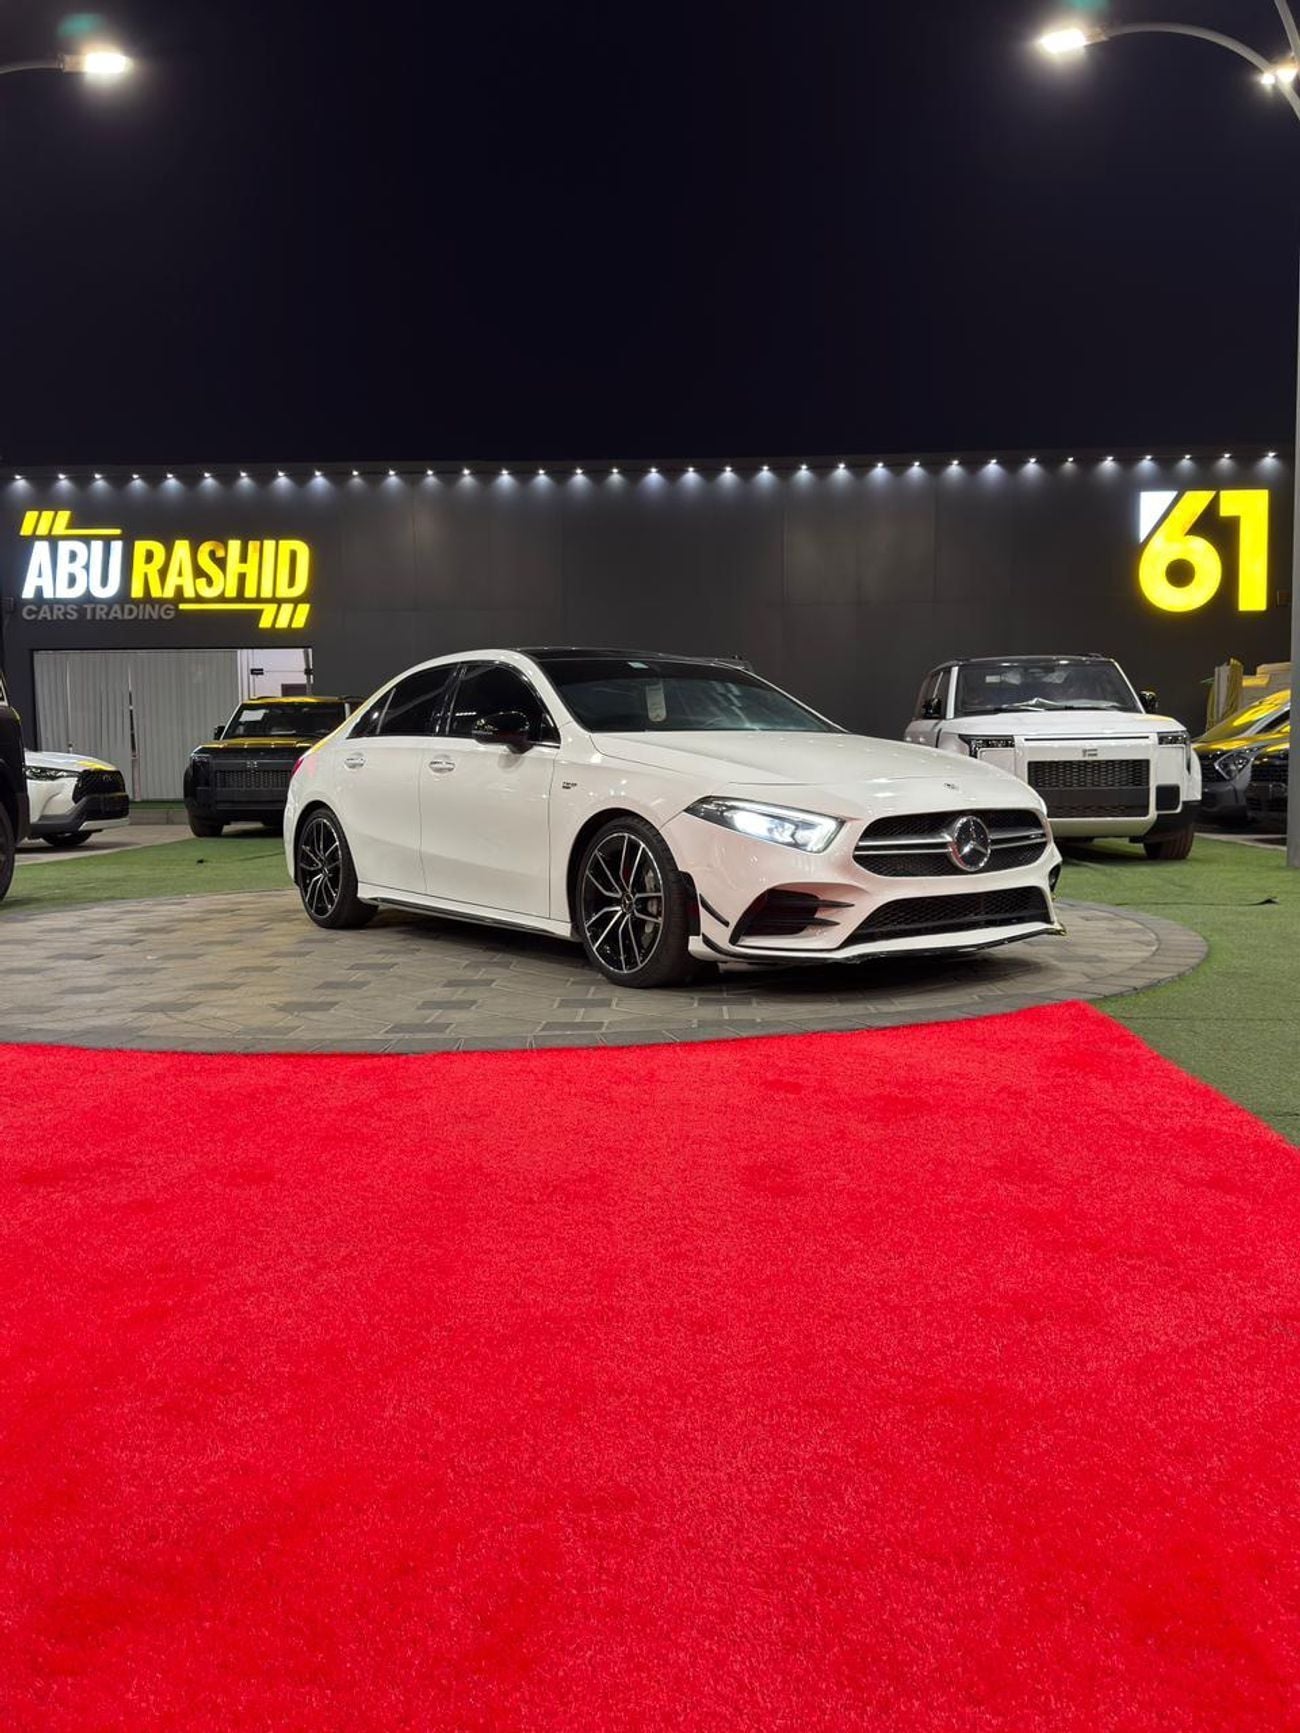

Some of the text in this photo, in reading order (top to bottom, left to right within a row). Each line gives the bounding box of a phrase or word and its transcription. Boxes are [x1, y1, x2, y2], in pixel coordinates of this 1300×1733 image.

[22, 540, 310, 598] ABU RASHID
[1139, 489, 1269, 612] 61
[22, 605, 176, 620] CARS TRADING
